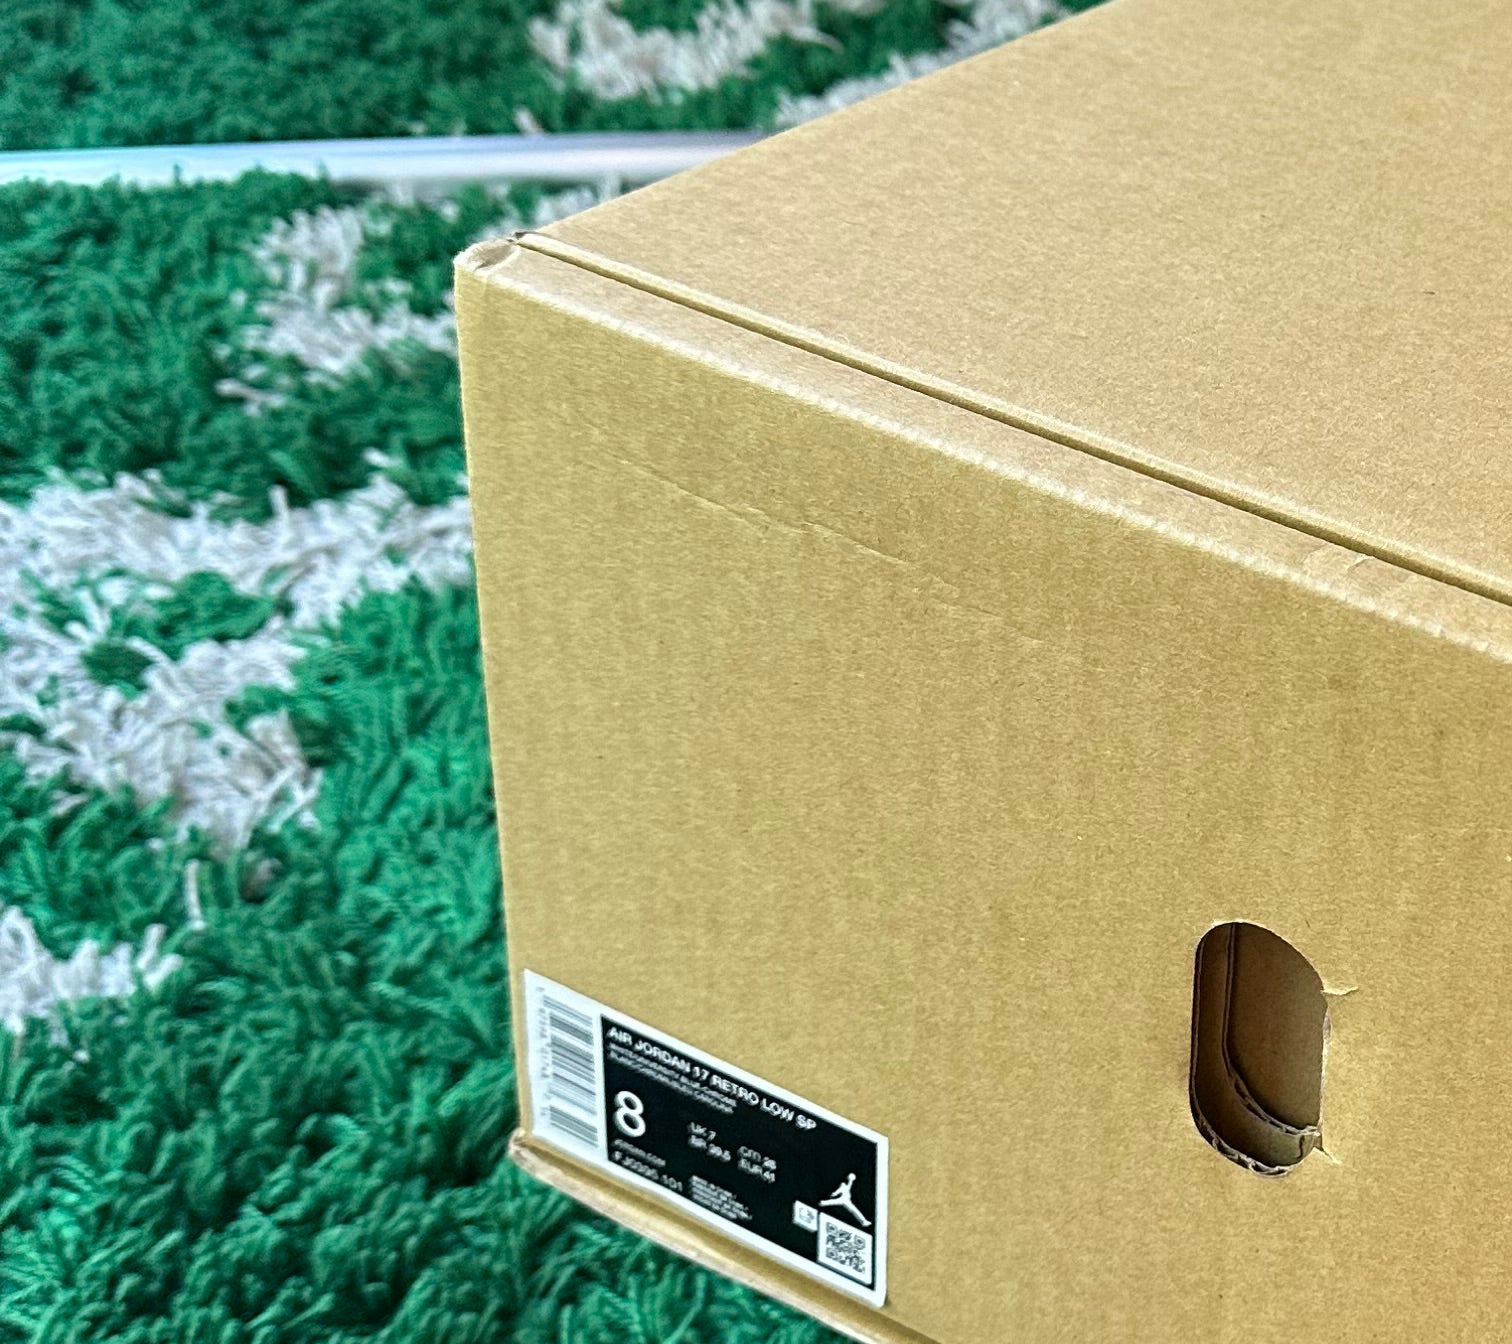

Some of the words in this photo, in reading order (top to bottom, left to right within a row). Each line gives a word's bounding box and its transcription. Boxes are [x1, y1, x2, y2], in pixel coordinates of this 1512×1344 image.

[607, 1027, 632, 1046] AIR
[634, 1040, 691, 1074] JORDAN
[692, 1066, 710, 1081] 17
[709, 1074, 760, 1106] RETRO
[760, 1098, 795, 1123] LOW
[796, 1114, 817, 1130] SP
[613, 1090, 646, 1138] 8
